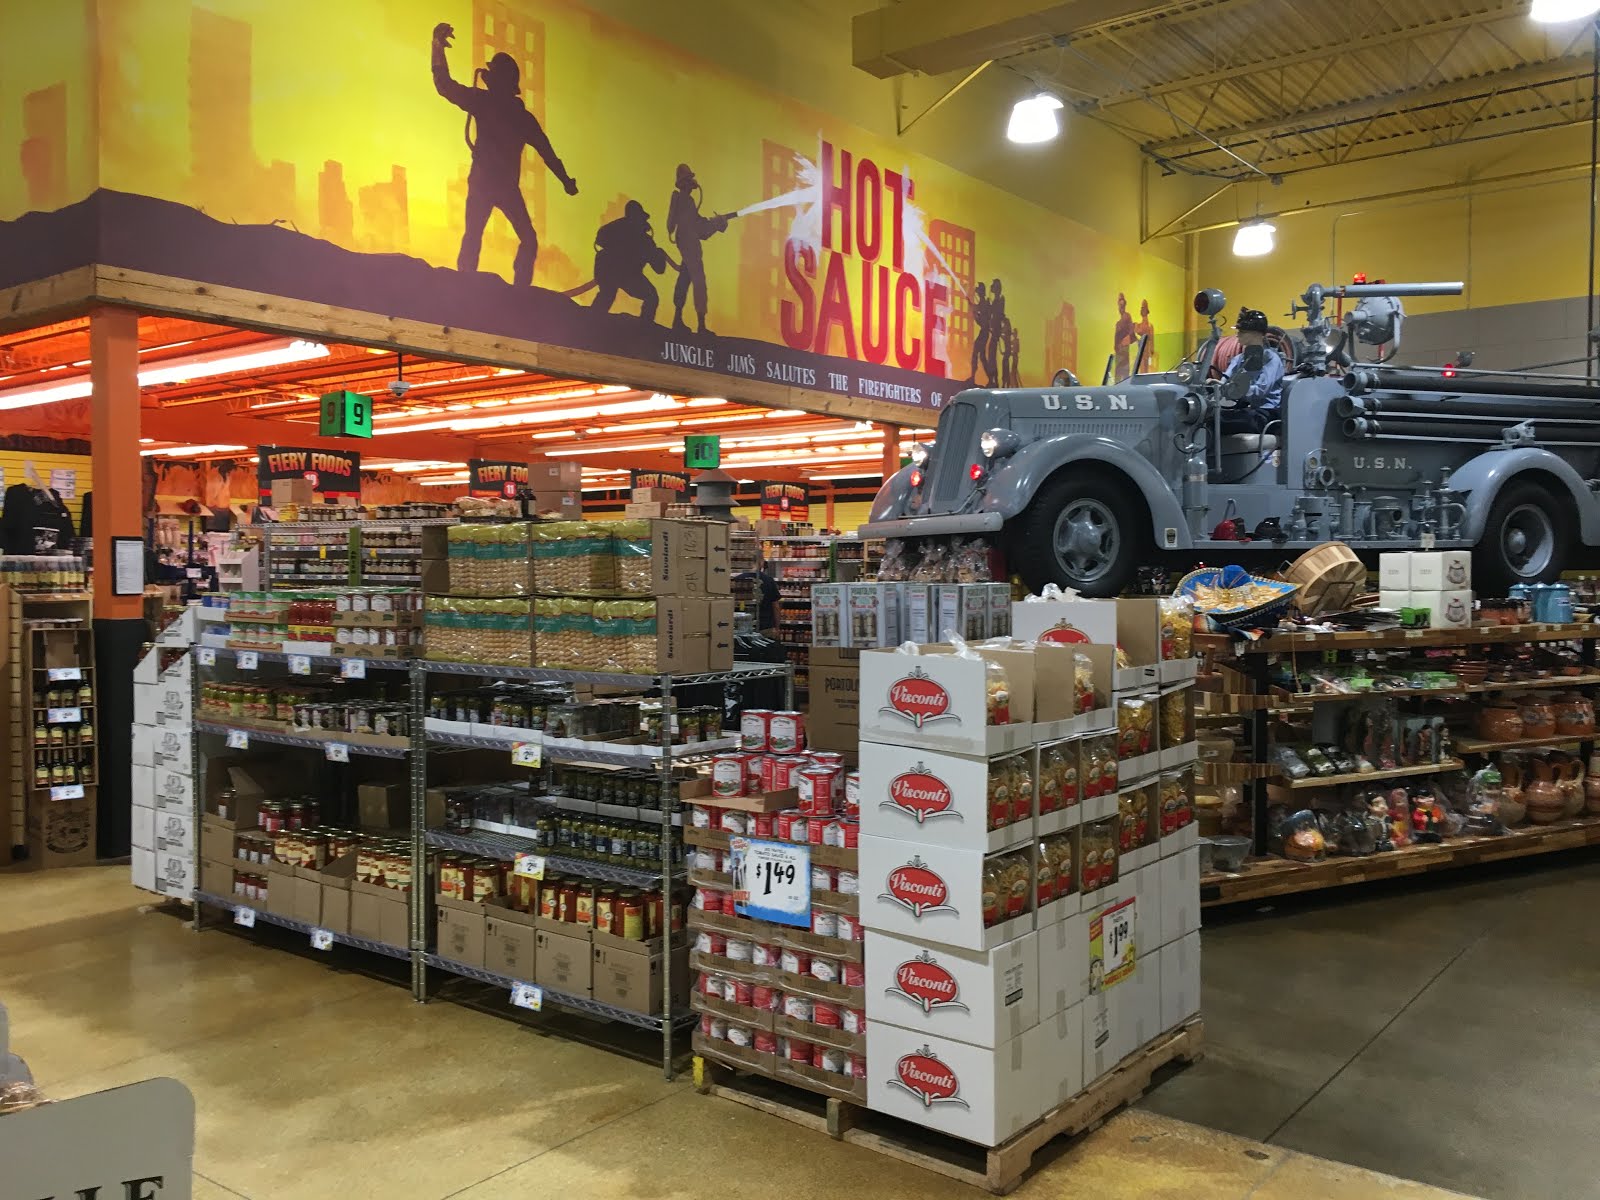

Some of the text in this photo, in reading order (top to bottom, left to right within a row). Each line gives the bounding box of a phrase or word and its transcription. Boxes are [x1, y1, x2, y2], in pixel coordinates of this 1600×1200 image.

[821, 139, 915, 275] HOT
[780, 237, 950, 379] SAUCE
[661, 341, 942, 407] JUNGLE JIM'S SALUTES THE FIREFIGHTERS OF
[354, 403, 363, 426] 9
[694, 442, 713, 460] 10
[268, 452, 352, 477] FIERY FOODS
[478, 465, 508, 483] FIERY
[507, 484, 515, 495] 11
[891, 685, 946, 707] Visconti
[893, 780, 949, 803] Visconti
[890, 872, 944, 898] Visconti
[898, 967, 954, 994] Visconti
[900, 1060, 954, 1090] Visconti
